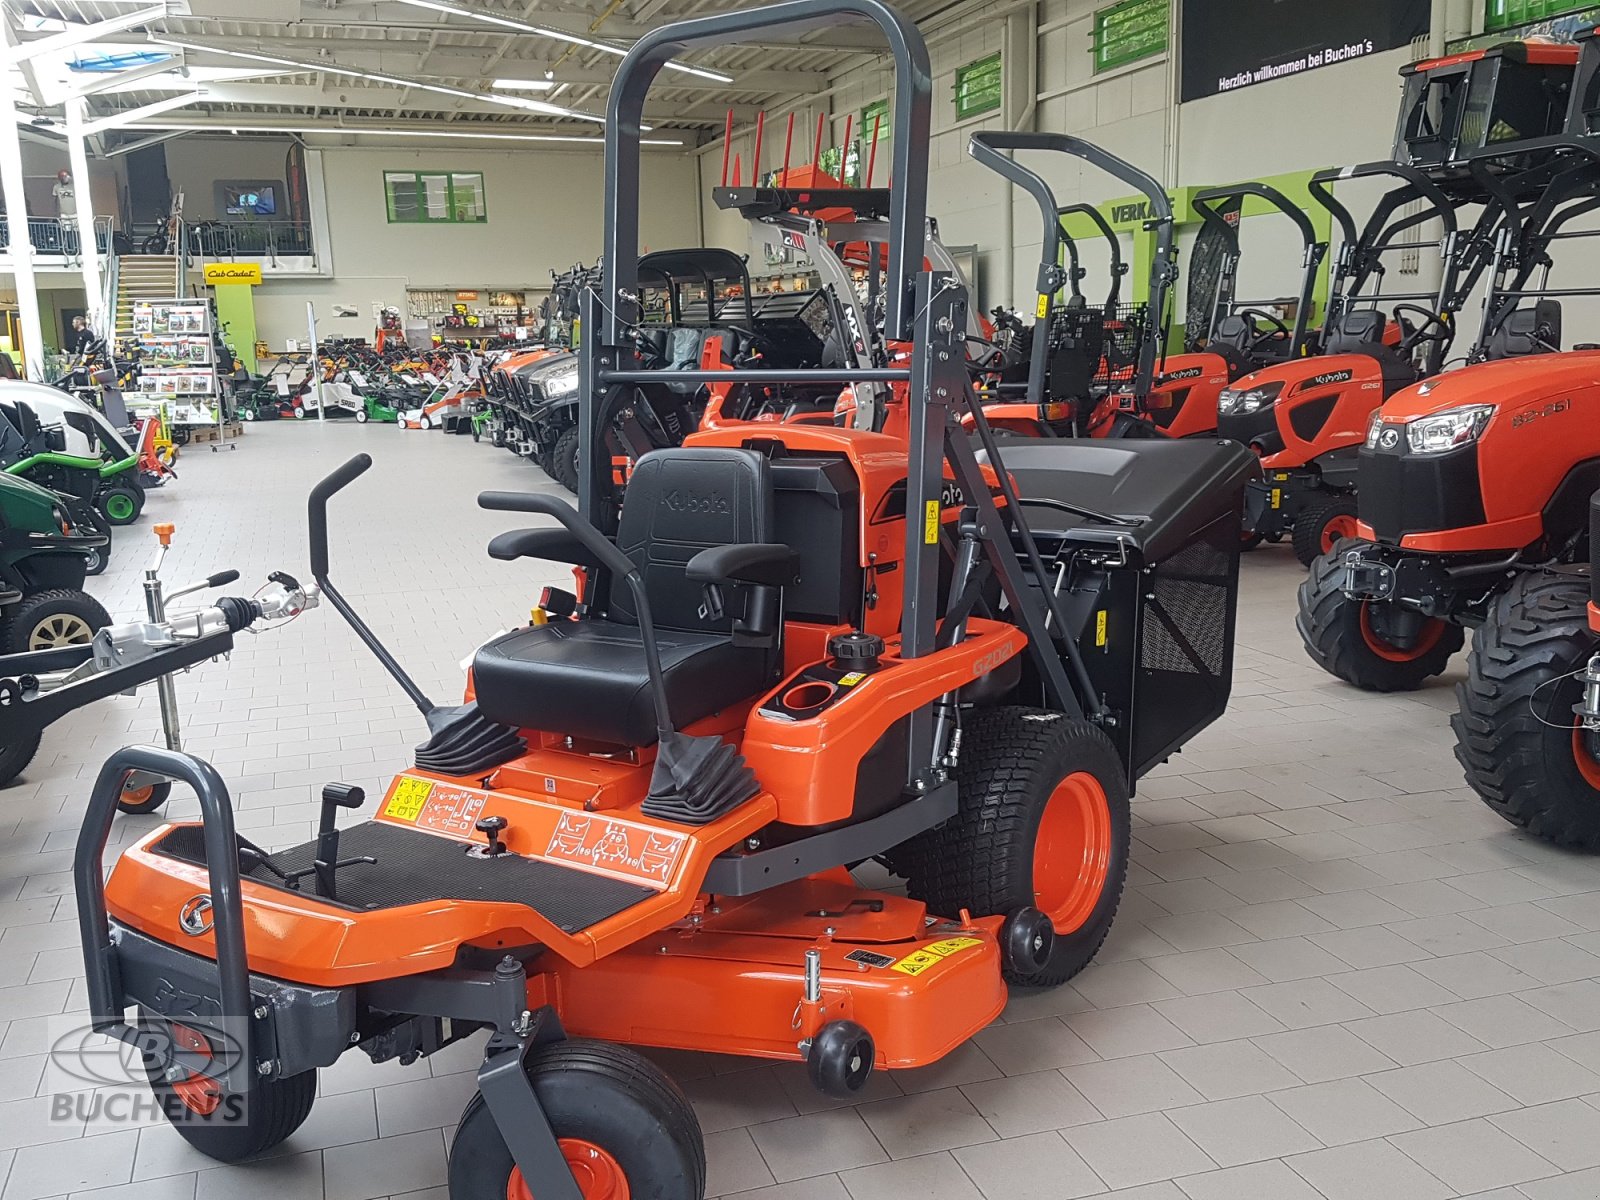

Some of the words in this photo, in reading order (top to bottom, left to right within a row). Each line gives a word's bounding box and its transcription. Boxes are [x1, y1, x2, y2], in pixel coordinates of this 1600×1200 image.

[1218, 71, 1252, 91] Herzlich
[1253, 58, 1306, 82] willkommen
[1307, 50, 1323, 69] bei
[208, 270, 226, 278] Cub
[226, 270, 256, 278] Cadet
[845, 306, 861, 341] MX
[1170, 368, 1200, 379] Kubota
[1315, 371, 1349, 384] Kubota
[660, 488, 731, 515] Kubota
